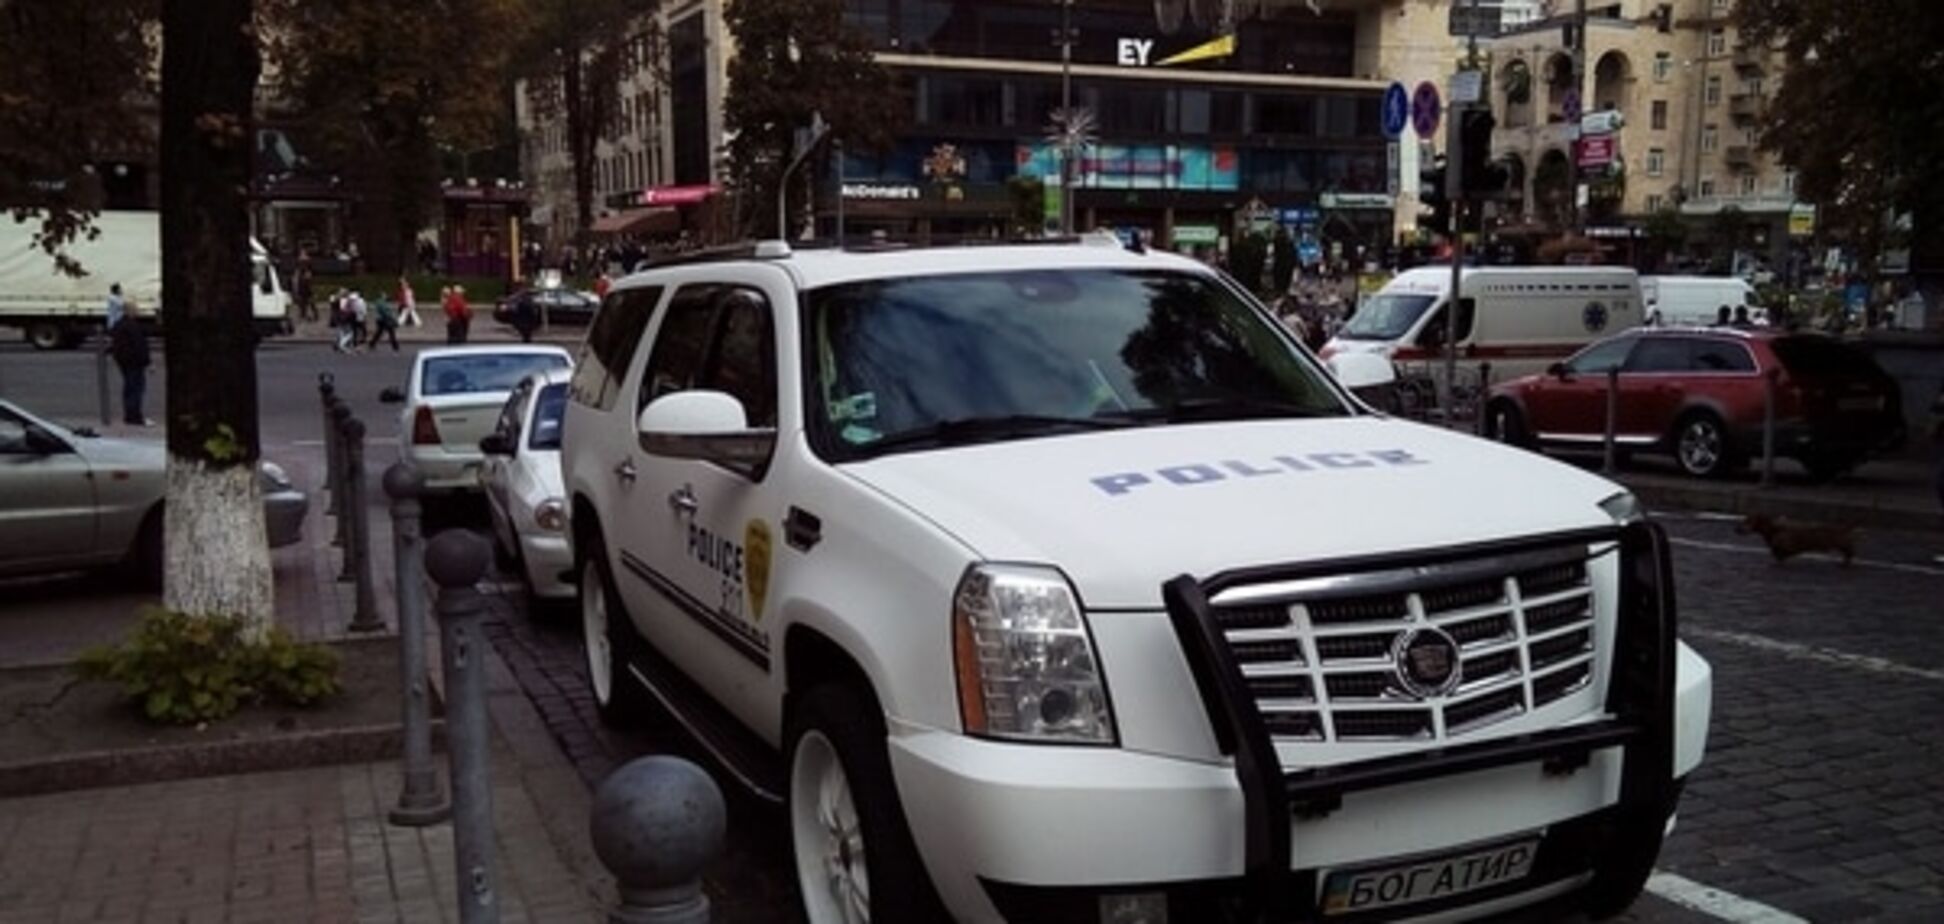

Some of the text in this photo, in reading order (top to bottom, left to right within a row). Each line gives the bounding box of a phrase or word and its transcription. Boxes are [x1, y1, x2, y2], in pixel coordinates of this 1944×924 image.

[1117, 38, 1154, 66] EY
[1089, 448, 1431, 496] POLICE
[687, 522, 743, 584] POLICE
[1350, 846, 1529, 906] БОГАТИР
